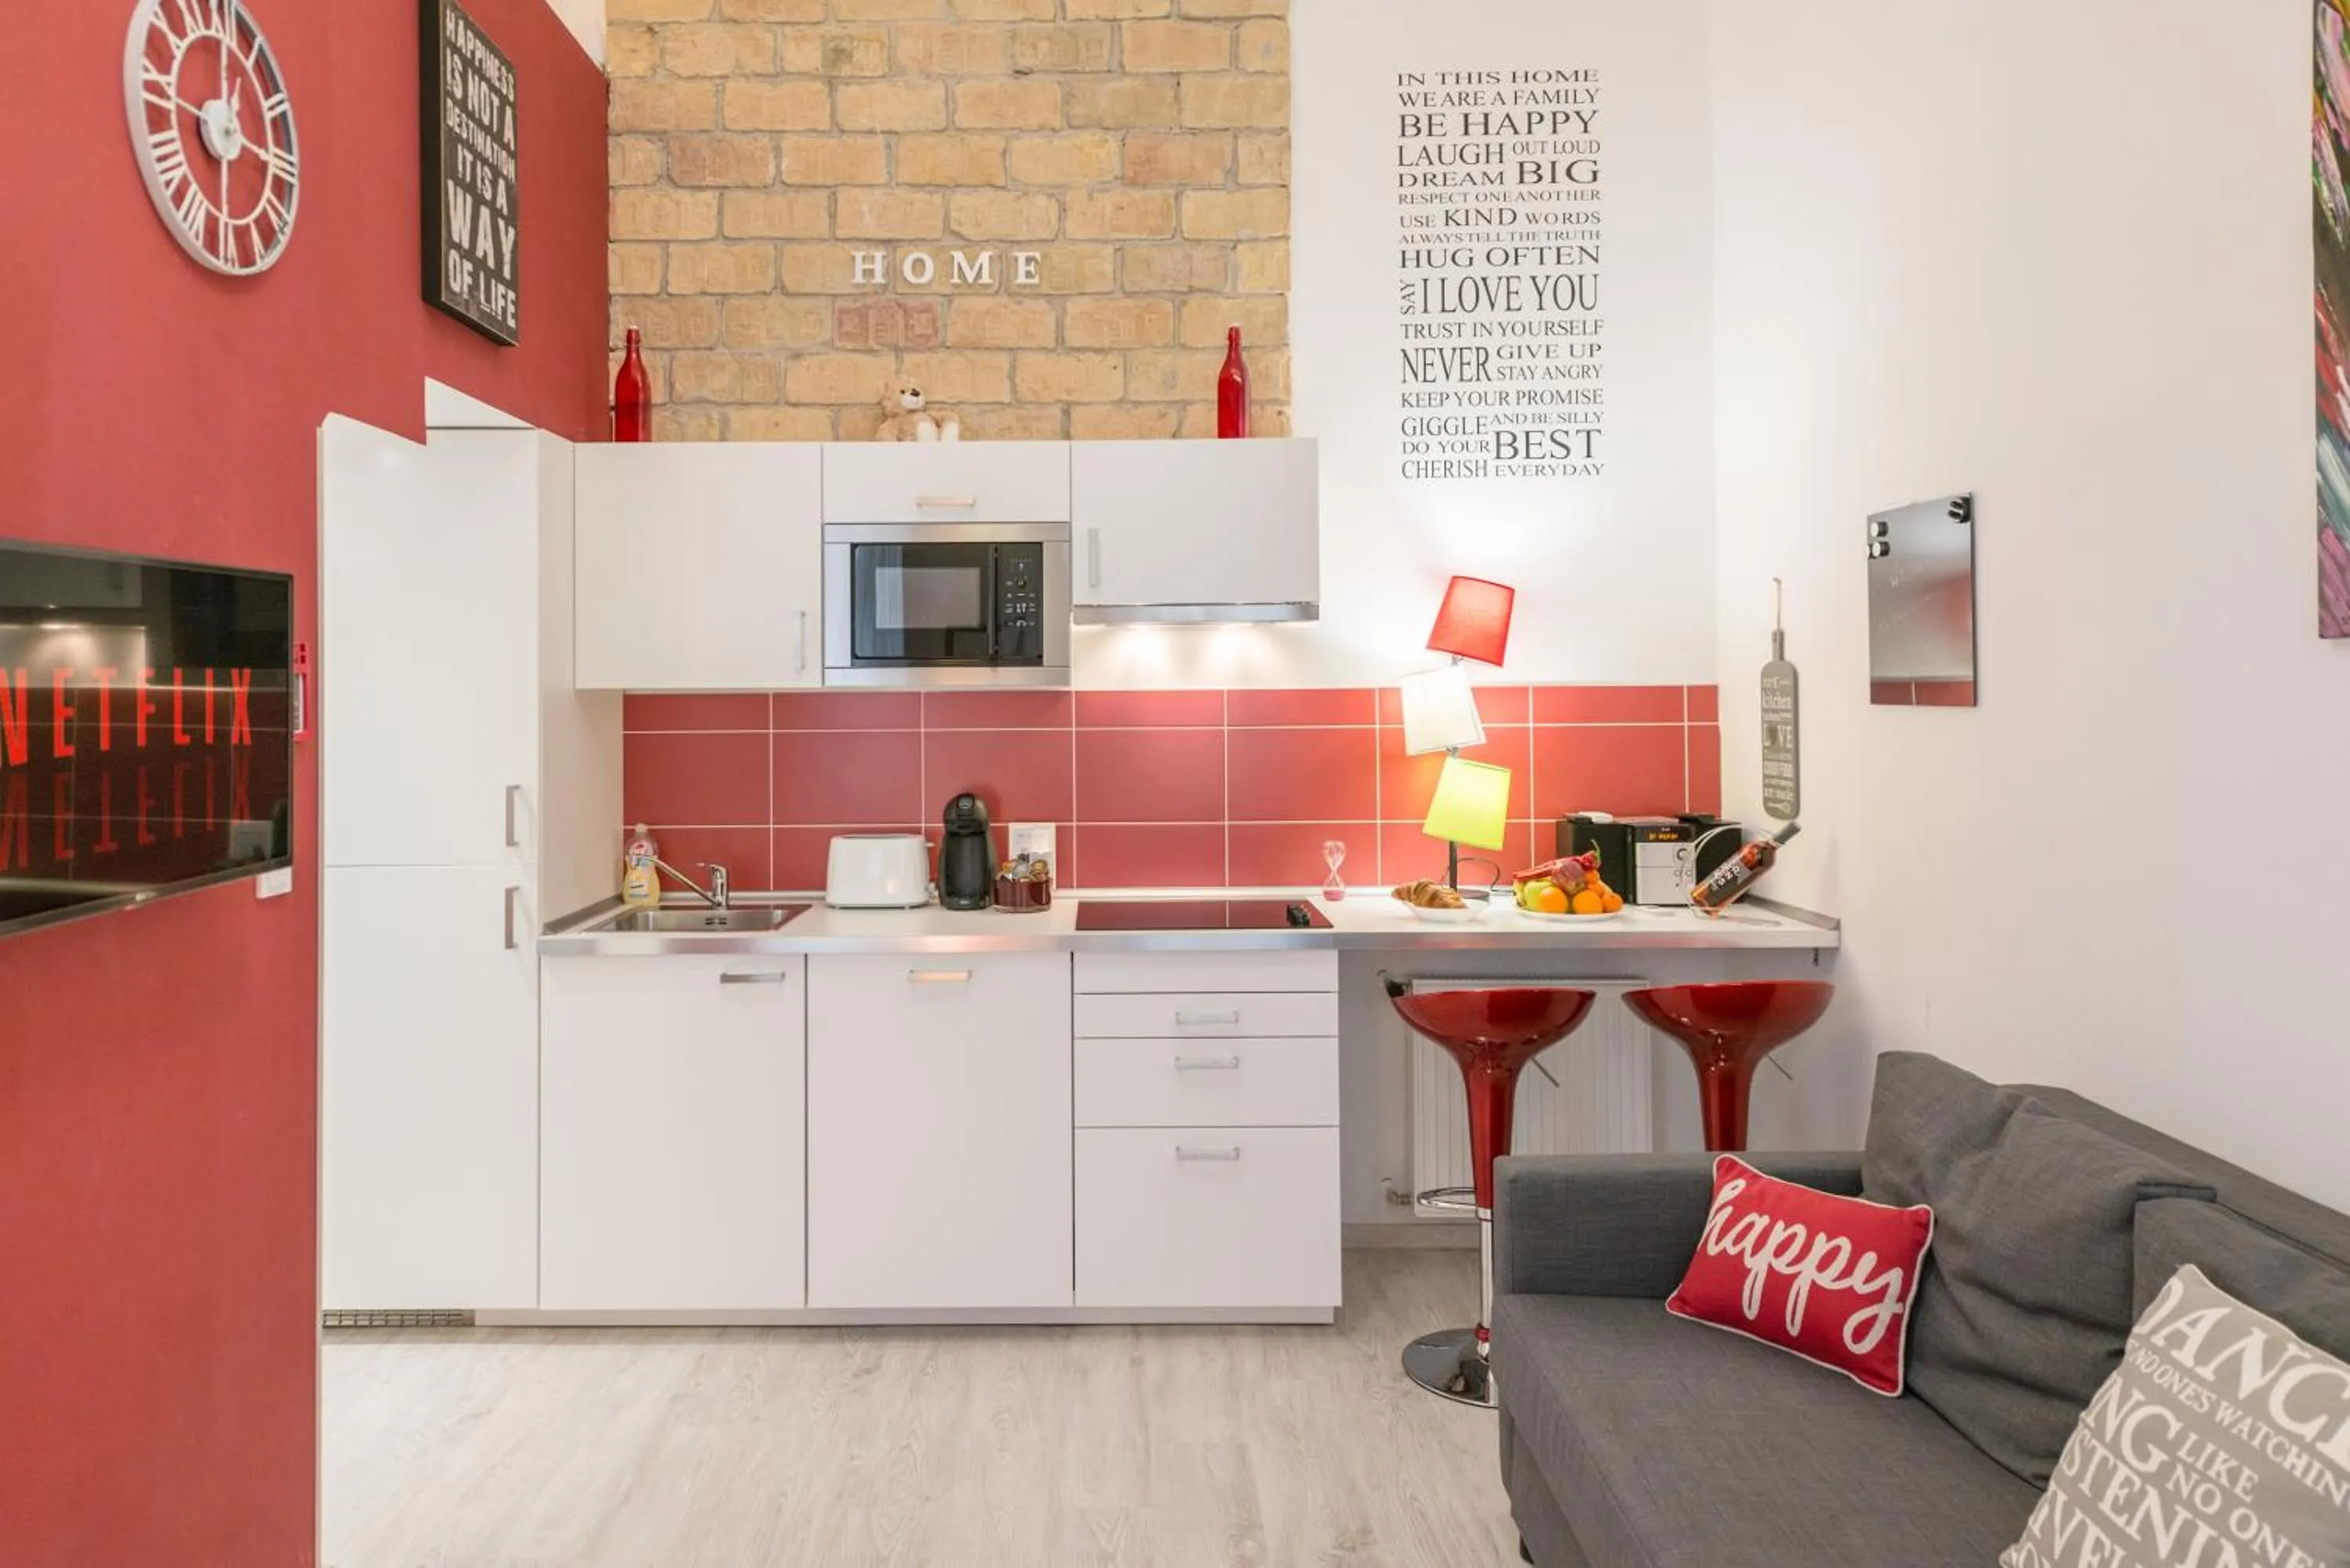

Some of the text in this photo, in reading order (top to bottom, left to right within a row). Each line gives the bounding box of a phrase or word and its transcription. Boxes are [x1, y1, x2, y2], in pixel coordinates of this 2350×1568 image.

[446, 6, 515, 102] HAPPINESS
[1397, 69, 1599, 87] IN THIS HOME
[446, 47, 515, 151] IS NOT A
[1397, 88, 1600, 107] WE ARE A FAMILY
[446, 97, 516, 184] DESTINATION
[1397, 109, 1599, 139] BE HAPPY
[1397, 139, 1601, 167] LAUGH OUT LOUD
[457, 143, 508, 216] IT IS A
[1398, 159, 1600, 188] DREAM BIG
[1397, 189, 1601, 205] RESPECT ONE ANOTHER
[447, 178, 515, 280] WAY
[1399, 208, 1601, 229] USE KIND WORDS
[1398, 229, 1600, 245] ALWAYS TELL THE TRUTH
[851, 250, 1041, 285] HOME
[1400, 244, 1600, 269] HUG OFTEN
[448, 248, 516, 329] OF LIFE
[1399, 273, 1600, 316] SAY I LOVE YOU
[1400, 319, 1605, 340] TRUST IN YOURSELF
[1400, 342, 1602, 385] NEVER GIVE UP
[1496, 363, 1603, 381] STAY ANGRY
[1401, 388, 1604, 409] KEEP YOUR PROMISE
[1401, 411, 1604, 437] GIGGLE AND BE SILLY
[1402, 428, 1602, 461] DO YOUR BEST
[1401, 458, 1605, 479] CHERISH EVERYDAY
[0, 667, 251, 768] NETFLIX
[1707, 1178, 1904, 1354] happy
[2176, 1431, 2261, 1503] LIKE
[2214, 1399, 2350, 1514] WATCHIN
[2165, 1463, 2326, 1568] NO ONE
